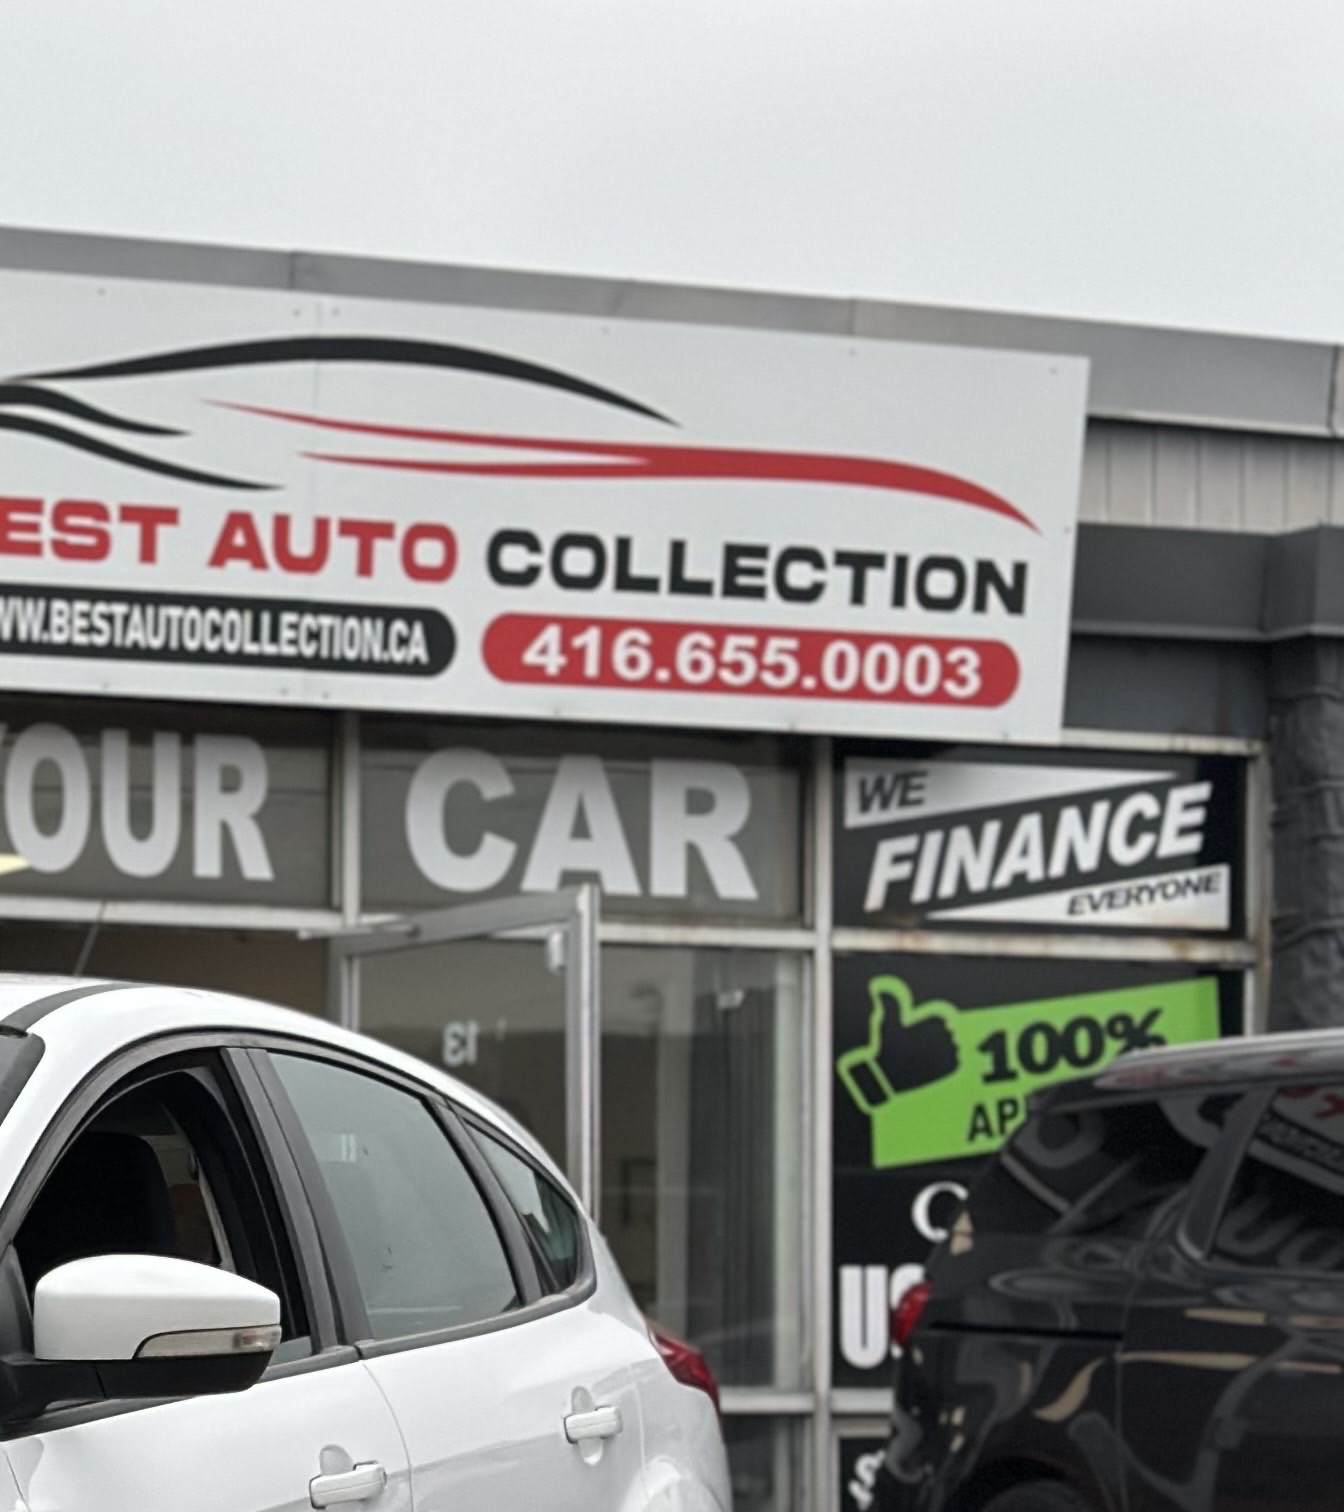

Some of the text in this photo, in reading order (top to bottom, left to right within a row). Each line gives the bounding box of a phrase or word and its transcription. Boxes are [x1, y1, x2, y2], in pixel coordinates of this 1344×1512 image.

[207, 510, 458, 584] AUTO
[485, 528, 1028, 616] COLLECTION
[521, 623, 982, 699] 416.655.0003
[404, 747, 760, 901] CAR
[858, 771, 928, 814] WE
[864, 781, 1212, 912] FINANCE
[1067, 871, 1222, 916] EVERYONE
[976, 1008, 1168, 1084] 100%
